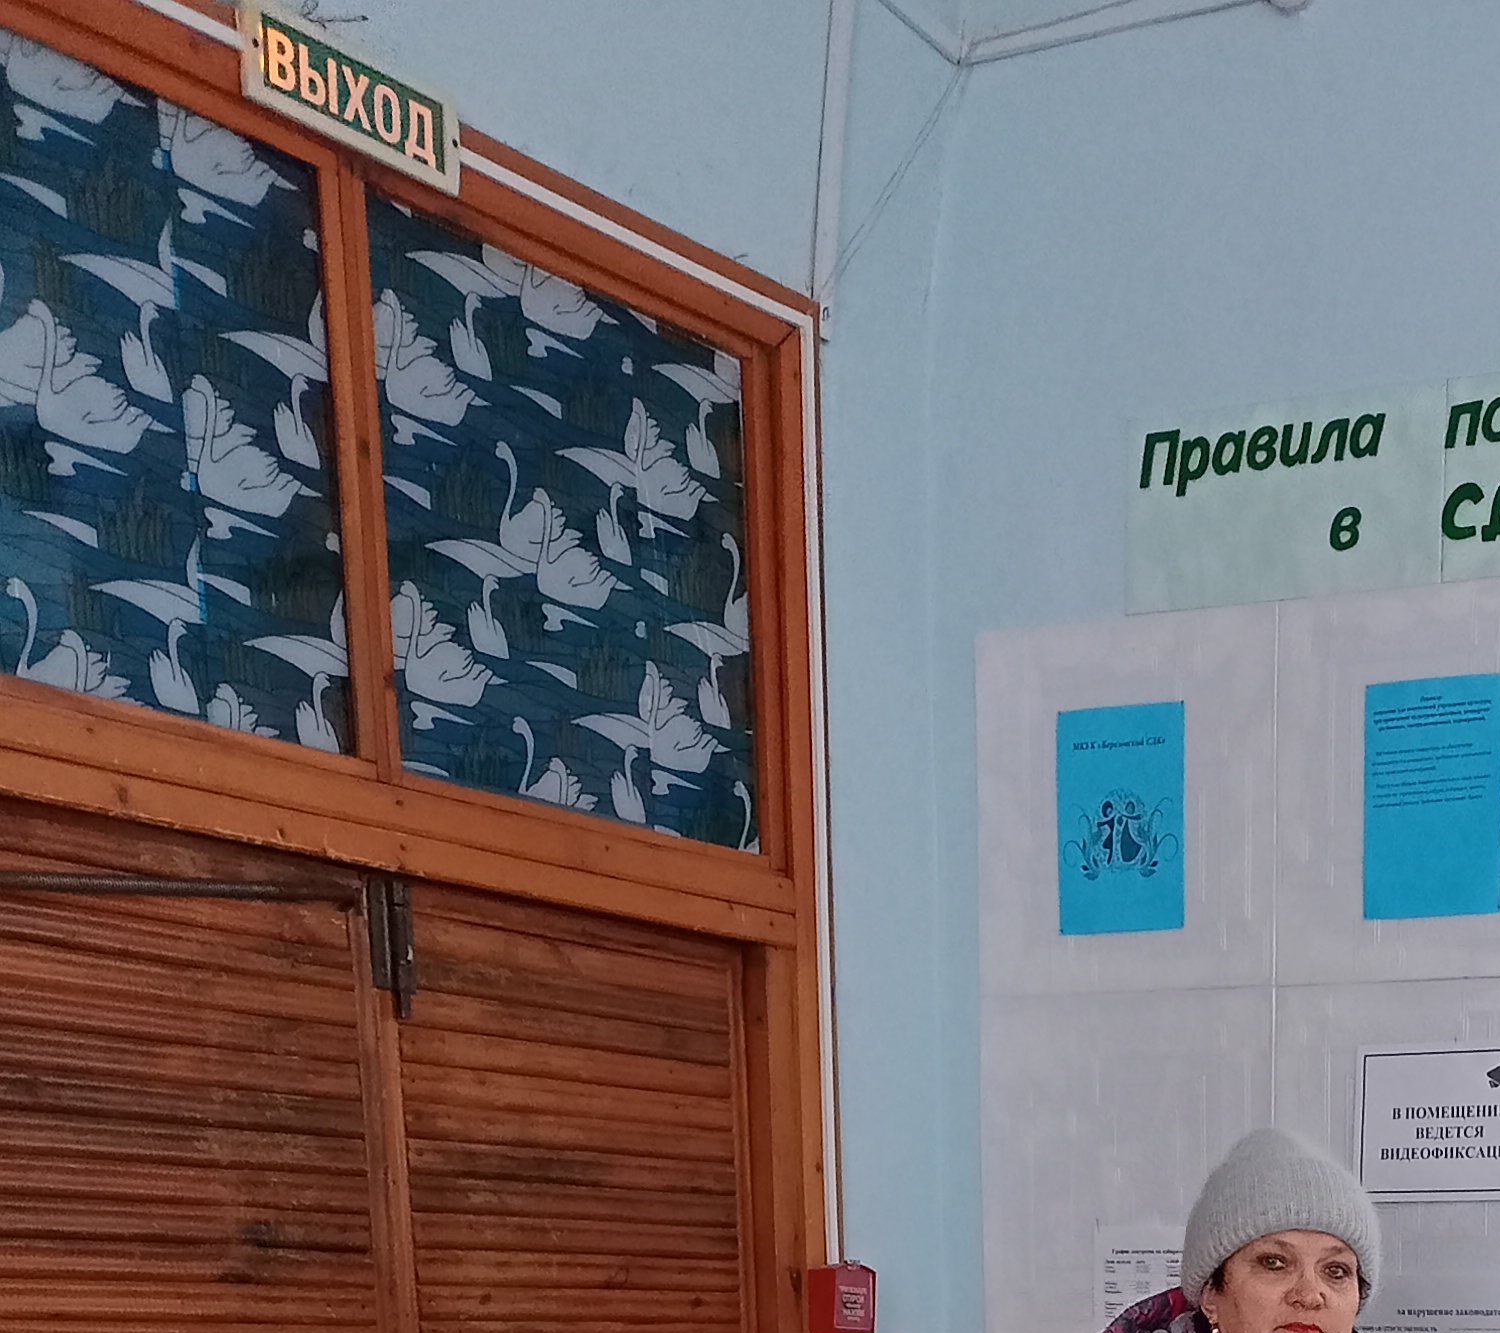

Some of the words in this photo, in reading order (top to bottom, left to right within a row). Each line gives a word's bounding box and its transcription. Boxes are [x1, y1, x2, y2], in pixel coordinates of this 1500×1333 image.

[266, 27, 436, 169] ВЫХОД
[1139, 412, 1386, 497] Правила
[1329, 506, 1362, 551] в
[1392, 1107, 1401, 1120] В
[1415, 1125, 1484, 1141] ВЕДЕТСЯ
[1407, 1308, 1453, 1318] нарушение
